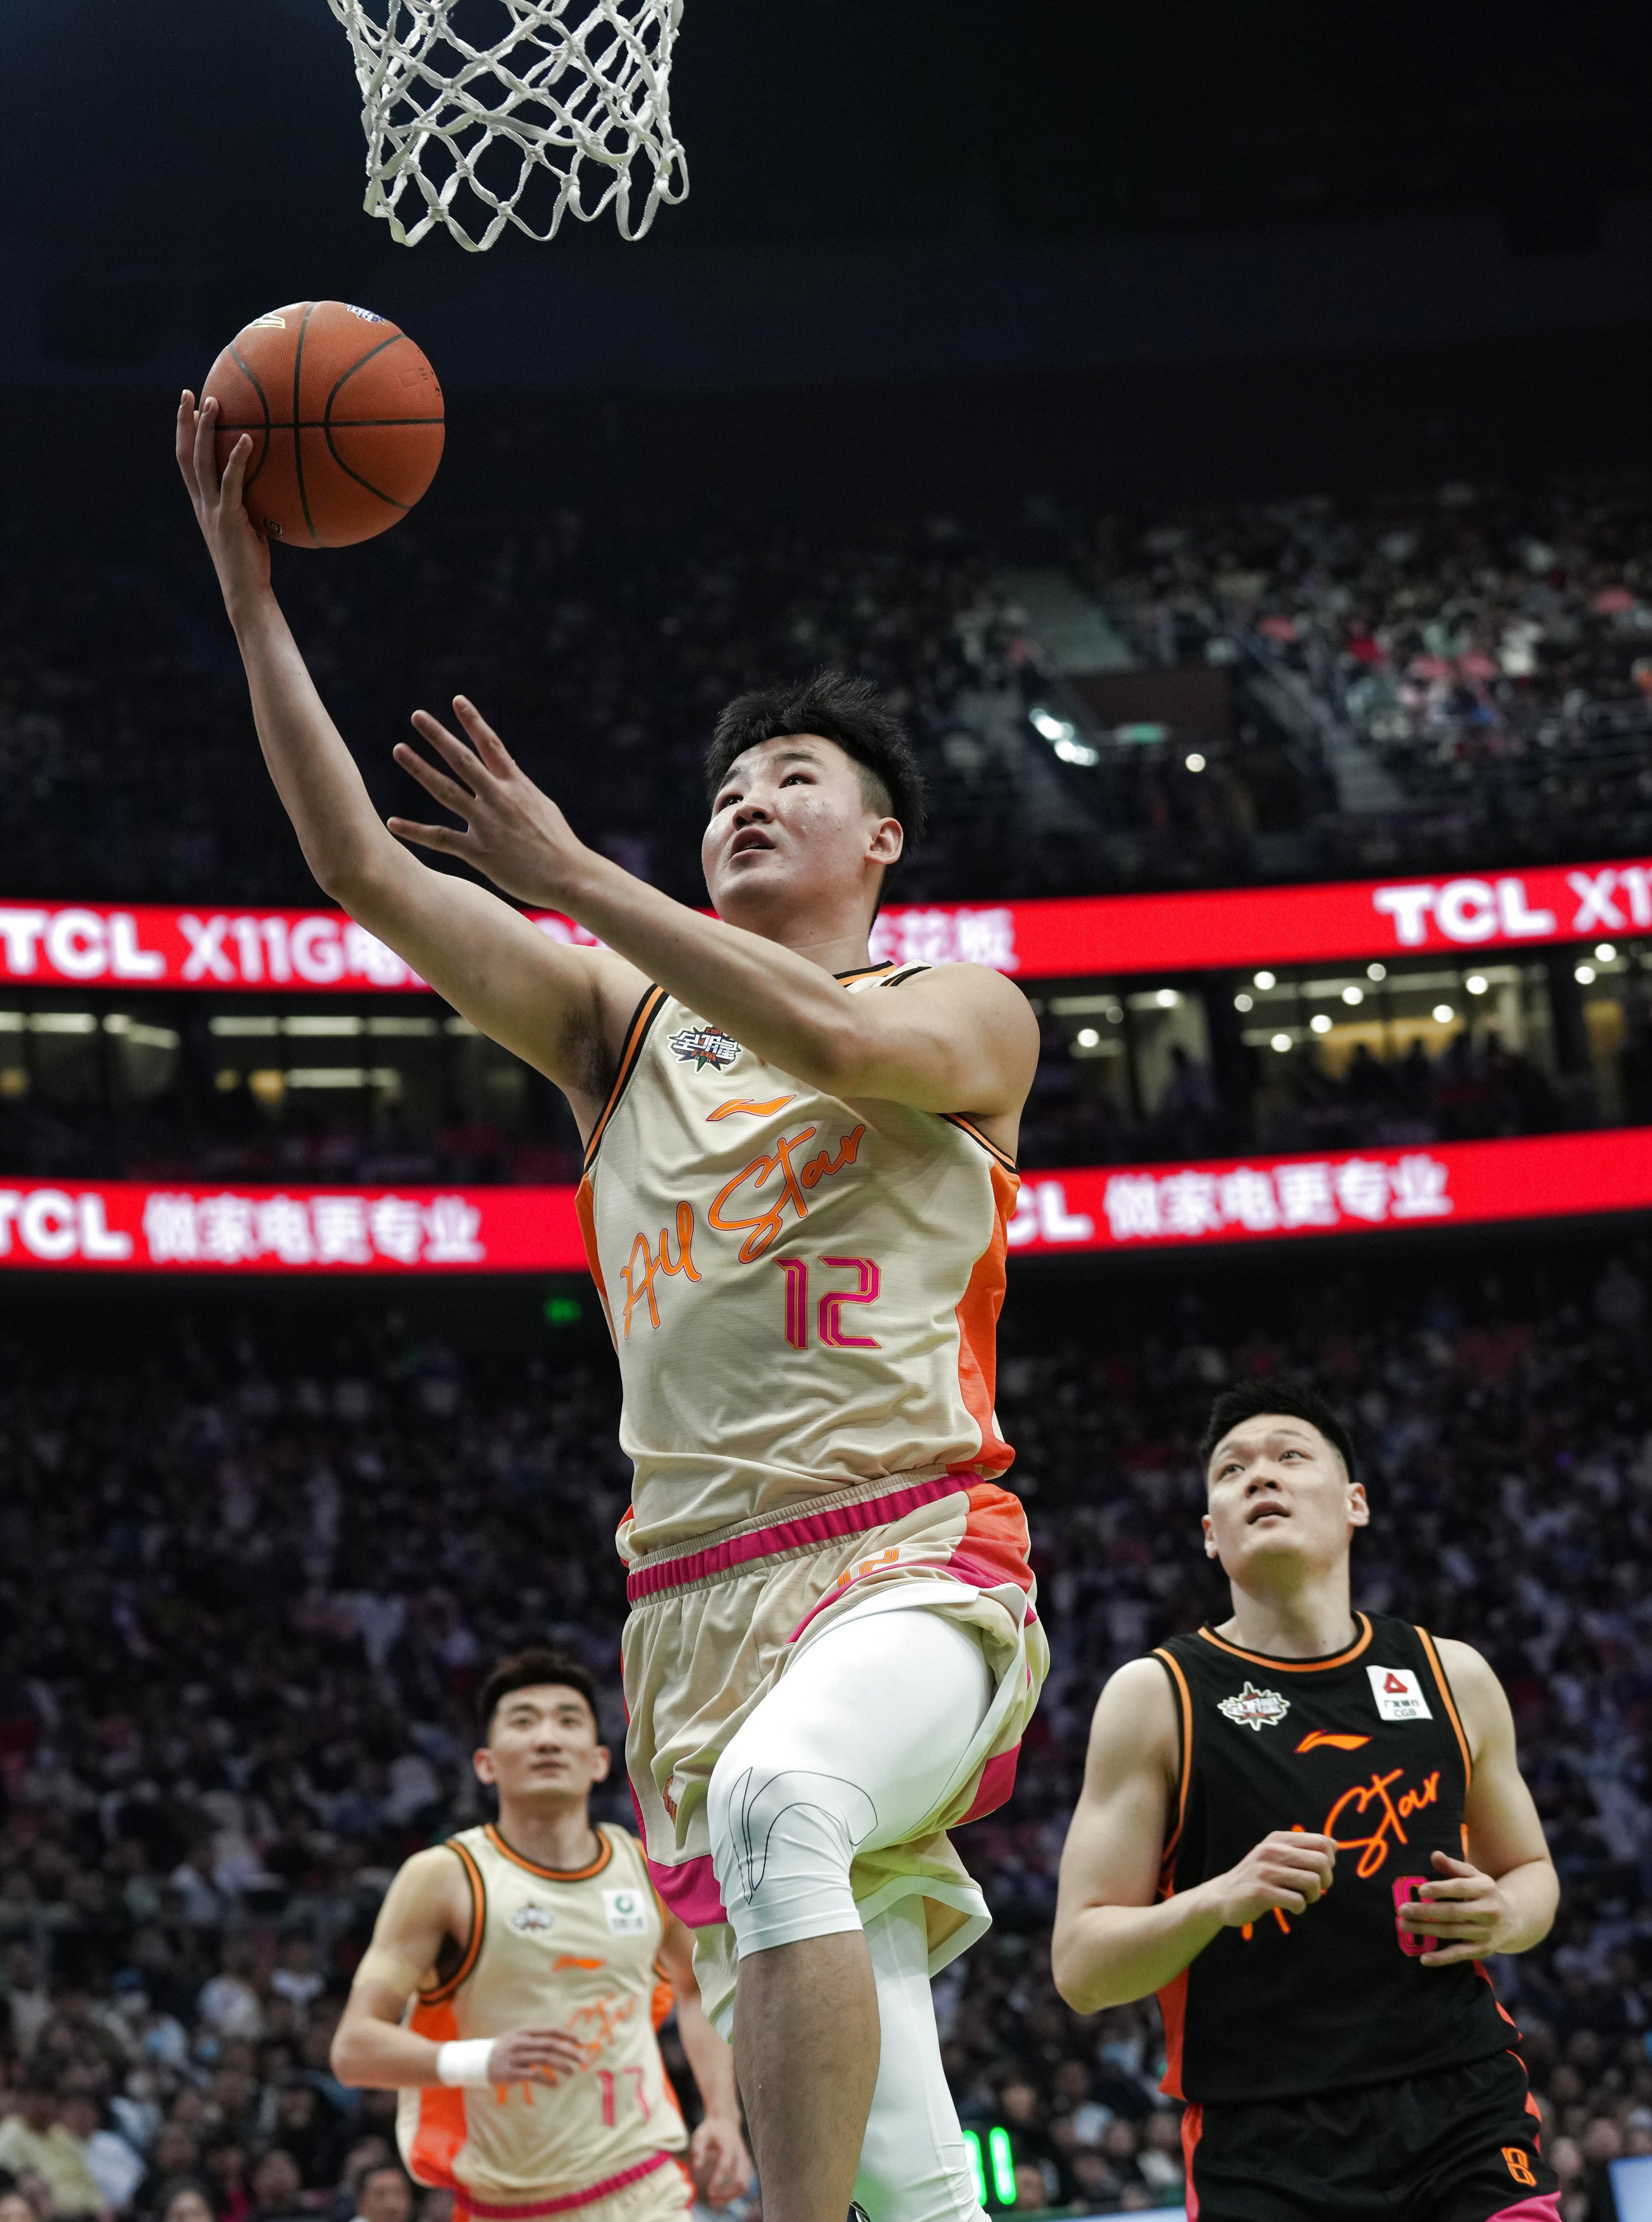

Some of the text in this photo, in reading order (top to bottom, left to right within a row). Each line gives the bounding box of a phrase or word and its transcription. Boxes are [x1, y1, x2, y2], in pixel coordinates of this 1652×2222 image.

[0, 907, 167, 979] TCL
[1373, 866, 1652, 947] TCL X1
[142, 1191, 487, 1266] 做家电更专业
[620, 1124, 866, 1339] All Star
[1104, 1152, 1454, 1242] 做家电更专业
[772, 1255, 882, 1350] 12
[1393, 1709, 1417, 1717] CGB
[1323, 1768, 1440, 1878] Star
